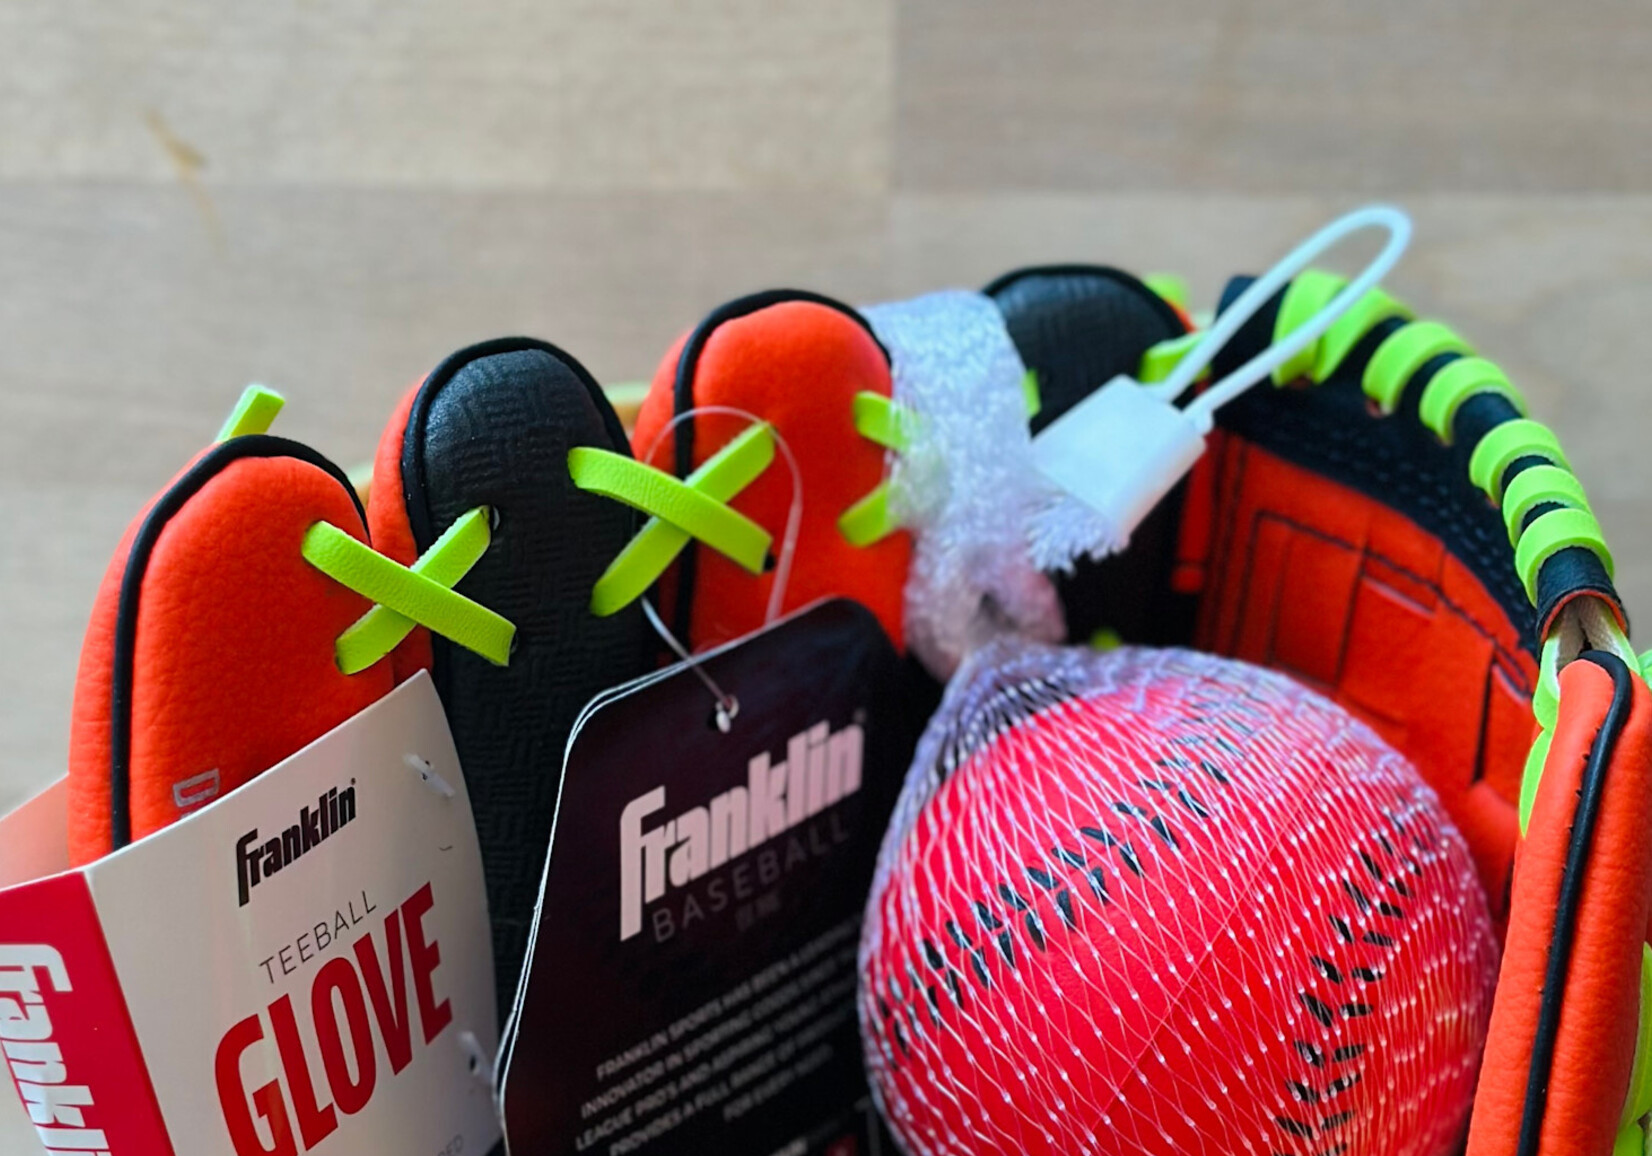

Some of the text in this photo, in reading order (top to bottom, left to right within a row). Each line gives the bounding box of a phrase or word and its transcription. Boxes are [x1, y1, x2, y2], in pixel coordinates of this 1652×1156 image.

[652, 812, 850, 943] BASEBALL
[259, 890, 377, 986] TEEBALL
[596, 1029, 668, 1081] FRANKLIN
[580, 1060, 666, 1120] INNOVATOR
[575, 1106, 633, 1151] LEAGUE
